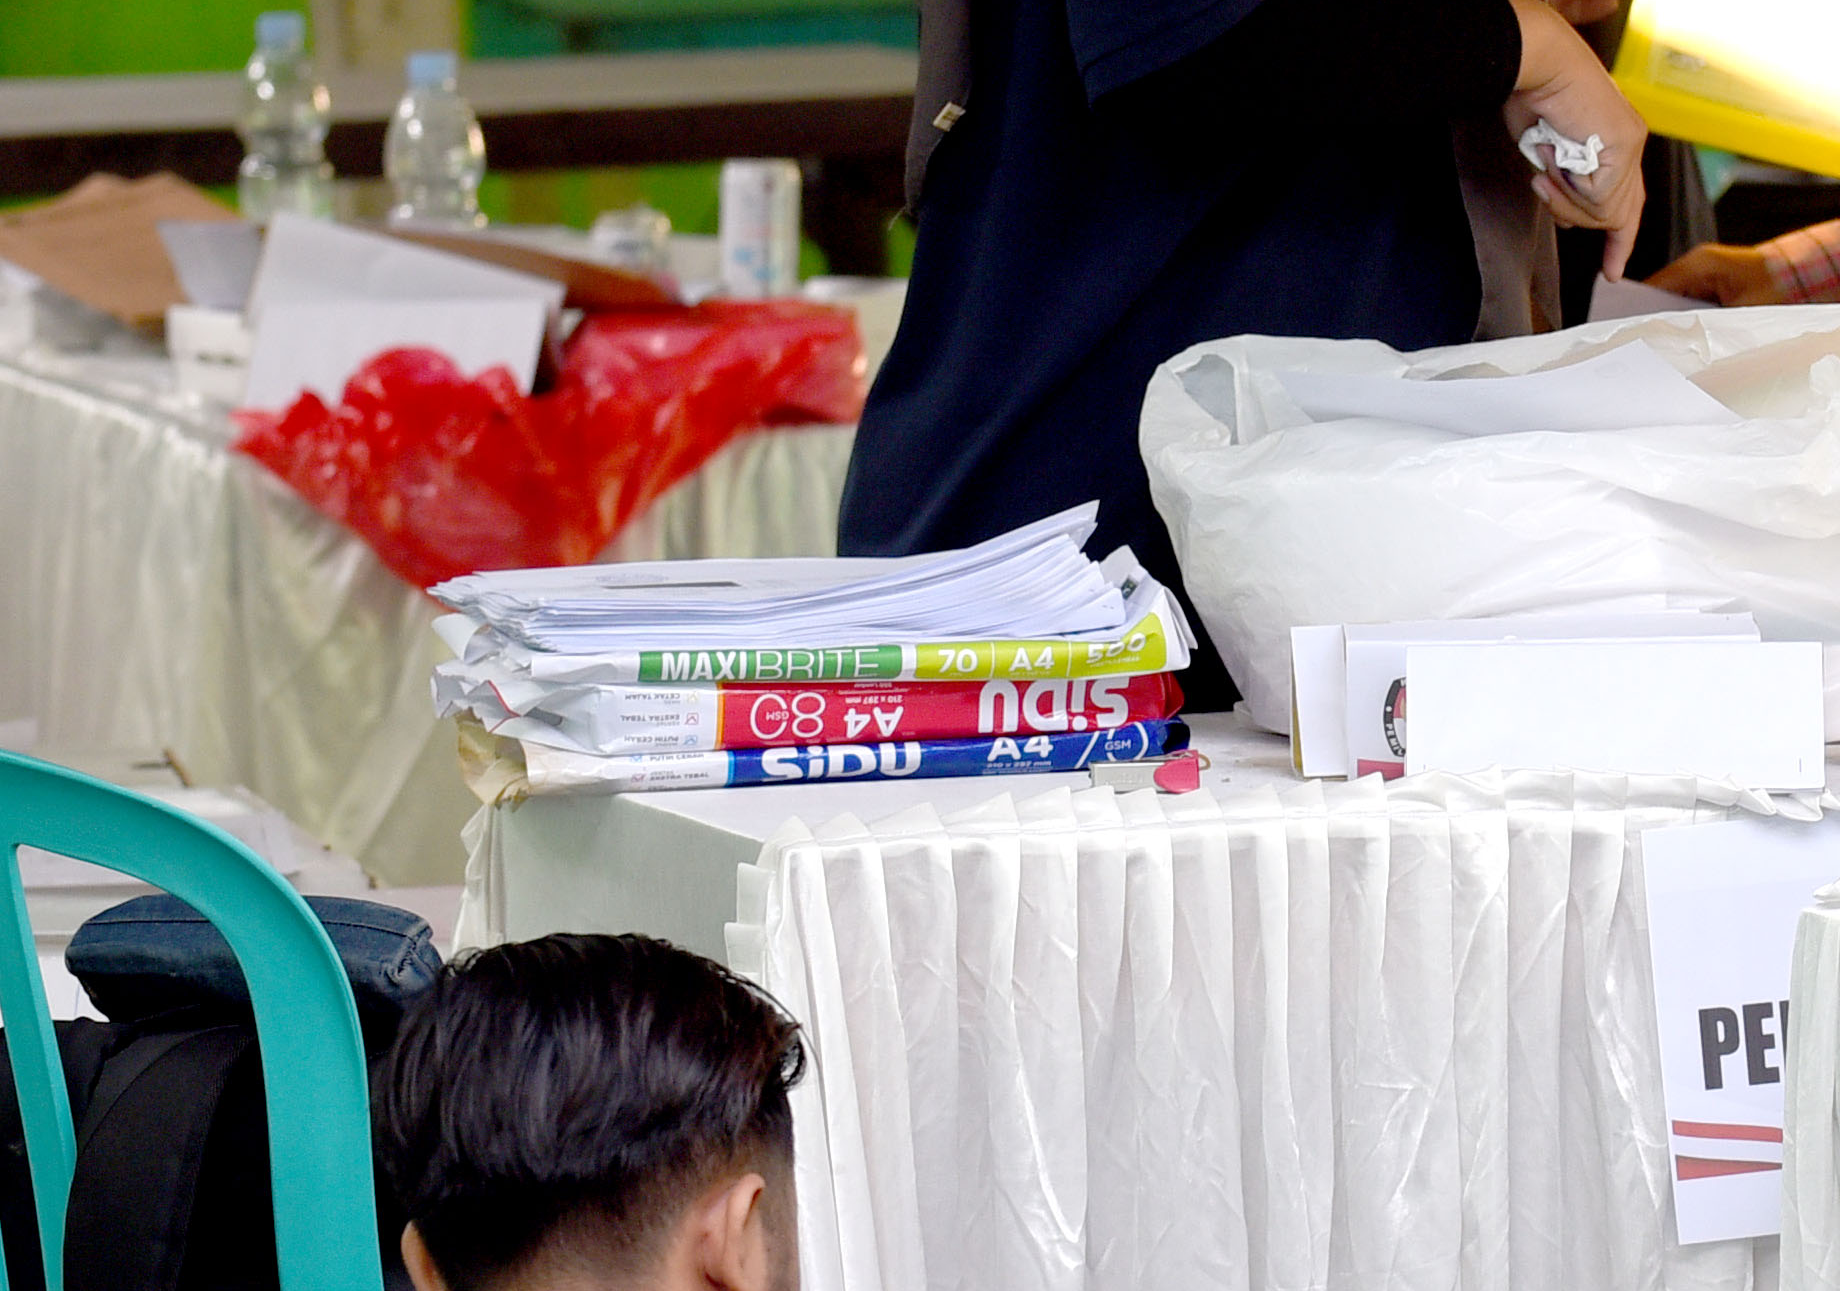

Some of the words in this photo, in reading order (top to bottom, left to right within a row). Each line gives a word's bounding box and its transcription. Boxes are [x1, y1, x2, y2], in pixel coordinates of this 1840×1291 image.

[938, 648, 979, 674] 70
[1008, 646, 1055, 673] A4
[1085, 632, 1147, 664] 500
[750, 691, 826, 740] 80
[765, 710, 790, 722] GSM
[843, 705, 905, 739] A4
[655, 735, 680, 743] PUTIH
[986, 735, 1054, 762] A4
[1103, 739, 1132, 751] GSM
